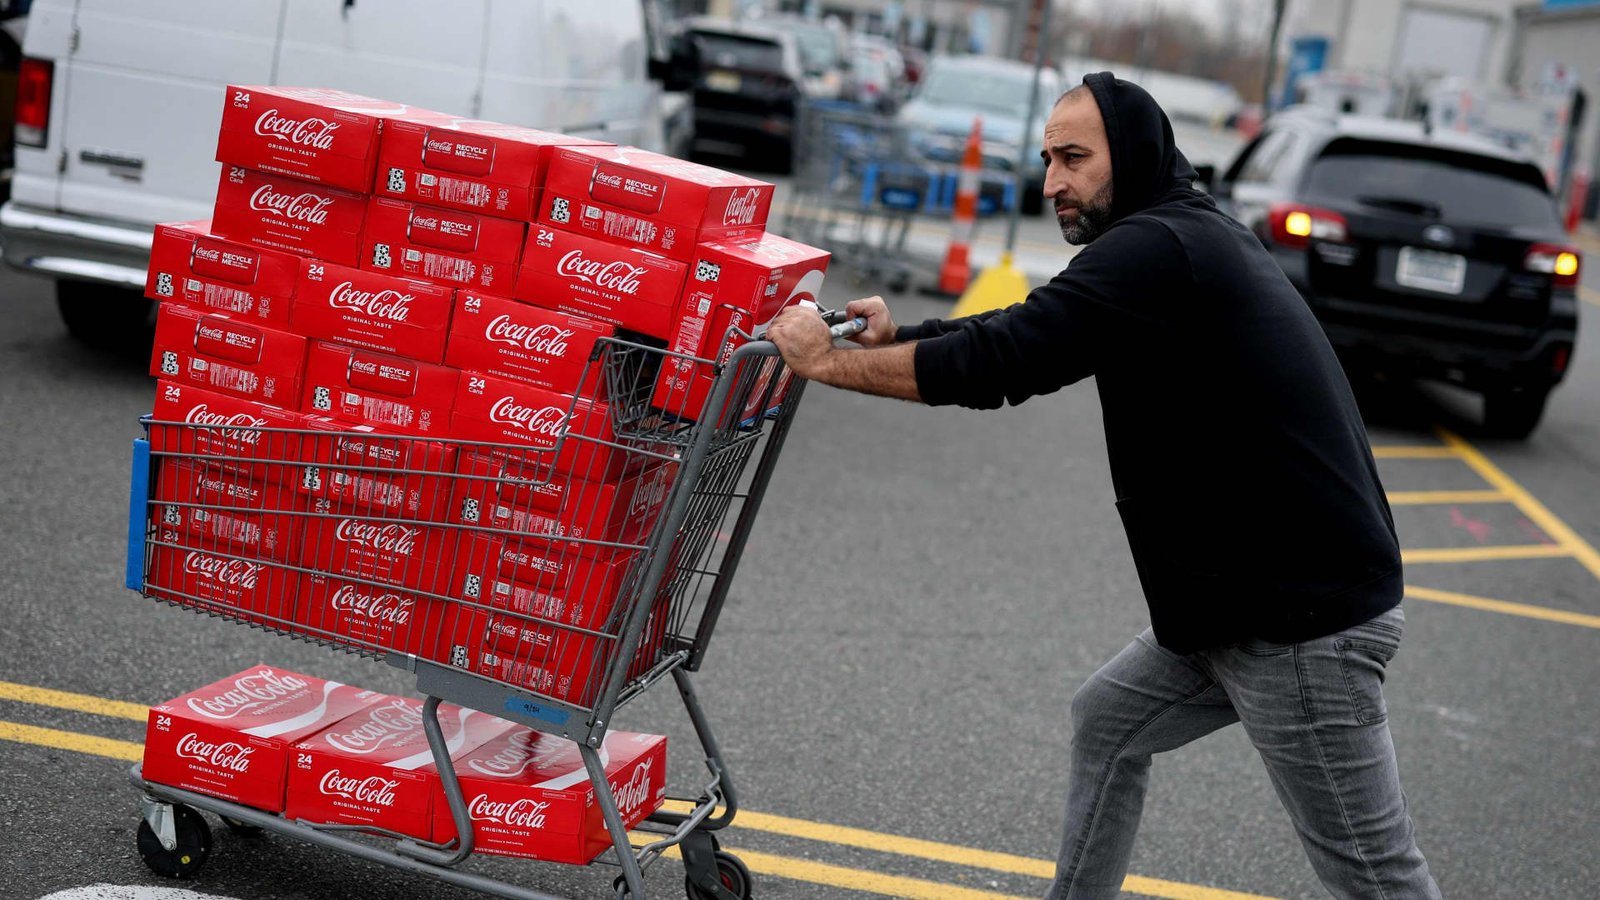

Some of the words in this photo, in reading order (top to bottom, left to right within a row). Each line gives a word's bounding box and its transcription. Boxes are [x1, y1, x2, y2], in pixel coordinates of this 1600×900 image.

[234, 92, 250, 103] 24
[254, 108, 341, 150] Coca-Cola
[268, 143, 296, 154] ORIGINAL
[298, 150, 317, 158] TASTE
[456, 144, 488, 154] RECYCLE
[230, 166, 246, 178] 24
[626, 178, 658, 192] RECYCLE
[250, 184, 335, 225] Coca-Cola
[261, 217, 290, 228] ORIGINAL
[292, 224, 310, 232] TASTE
[441, 220, 472, 232] RECYCLE
[537, 230, 554, 242] 24
[222, 252, 252, 264] RECYCLE
[308, 264, 324, 276] 24
[556, 250, 648, 296] Coca-Cola
[570, 284, 600, 296] ORIGINAL
[602, 292, 621, 302] TASTE
[329, 281, 416, 322] Coca-Cola
[464, 296, 482, 308] 24
[342, 314, 372, 326] ORIGINAL
[374, 320, 392, 329] TASTE
[226, 332, 256, 344] RECYCLE
[485, 314, 576, 358] Coca-Cola
[498, 348, 528, 360] ORIGINAL
[530, 355, 550, 364] TASTE
[380, 365, 411, 376] RECYCLE
[468, 378, 486, 390] 24
[165, 386, 181, 398] 24
[198, 436, 224, 448] ORIINAL
[227, 443, 245, 452] TASE
[502, 430, 532, 442] ORIGINAL
[534, 437, 554, 446] TASTE
[228, 484, 258, 496] RCYCLE
[316, 498, 330, 510] 24
[380, 555, 399, 563] TASE
[374, 623, 392, 632] TSTE
[187, 668, 309, 720] Coca-Cola
[156, 716, 172, 726] 24
[176, 732, 256, 774] Coca-Cola
[298, 754, 312, 764] 24
[188, 764, 216, 775] ORIGINAL
[217, 770, 234, 779] TASTE
[320, 768, 401, 806] Coca-Cola
[333, 800, 361, 810] ORIGINAL
[362, 806, 381, 814] TASTE
[468, 794, 552, 829] Coca-Cola
[481, 826, 510, 835] ORIGINAL
